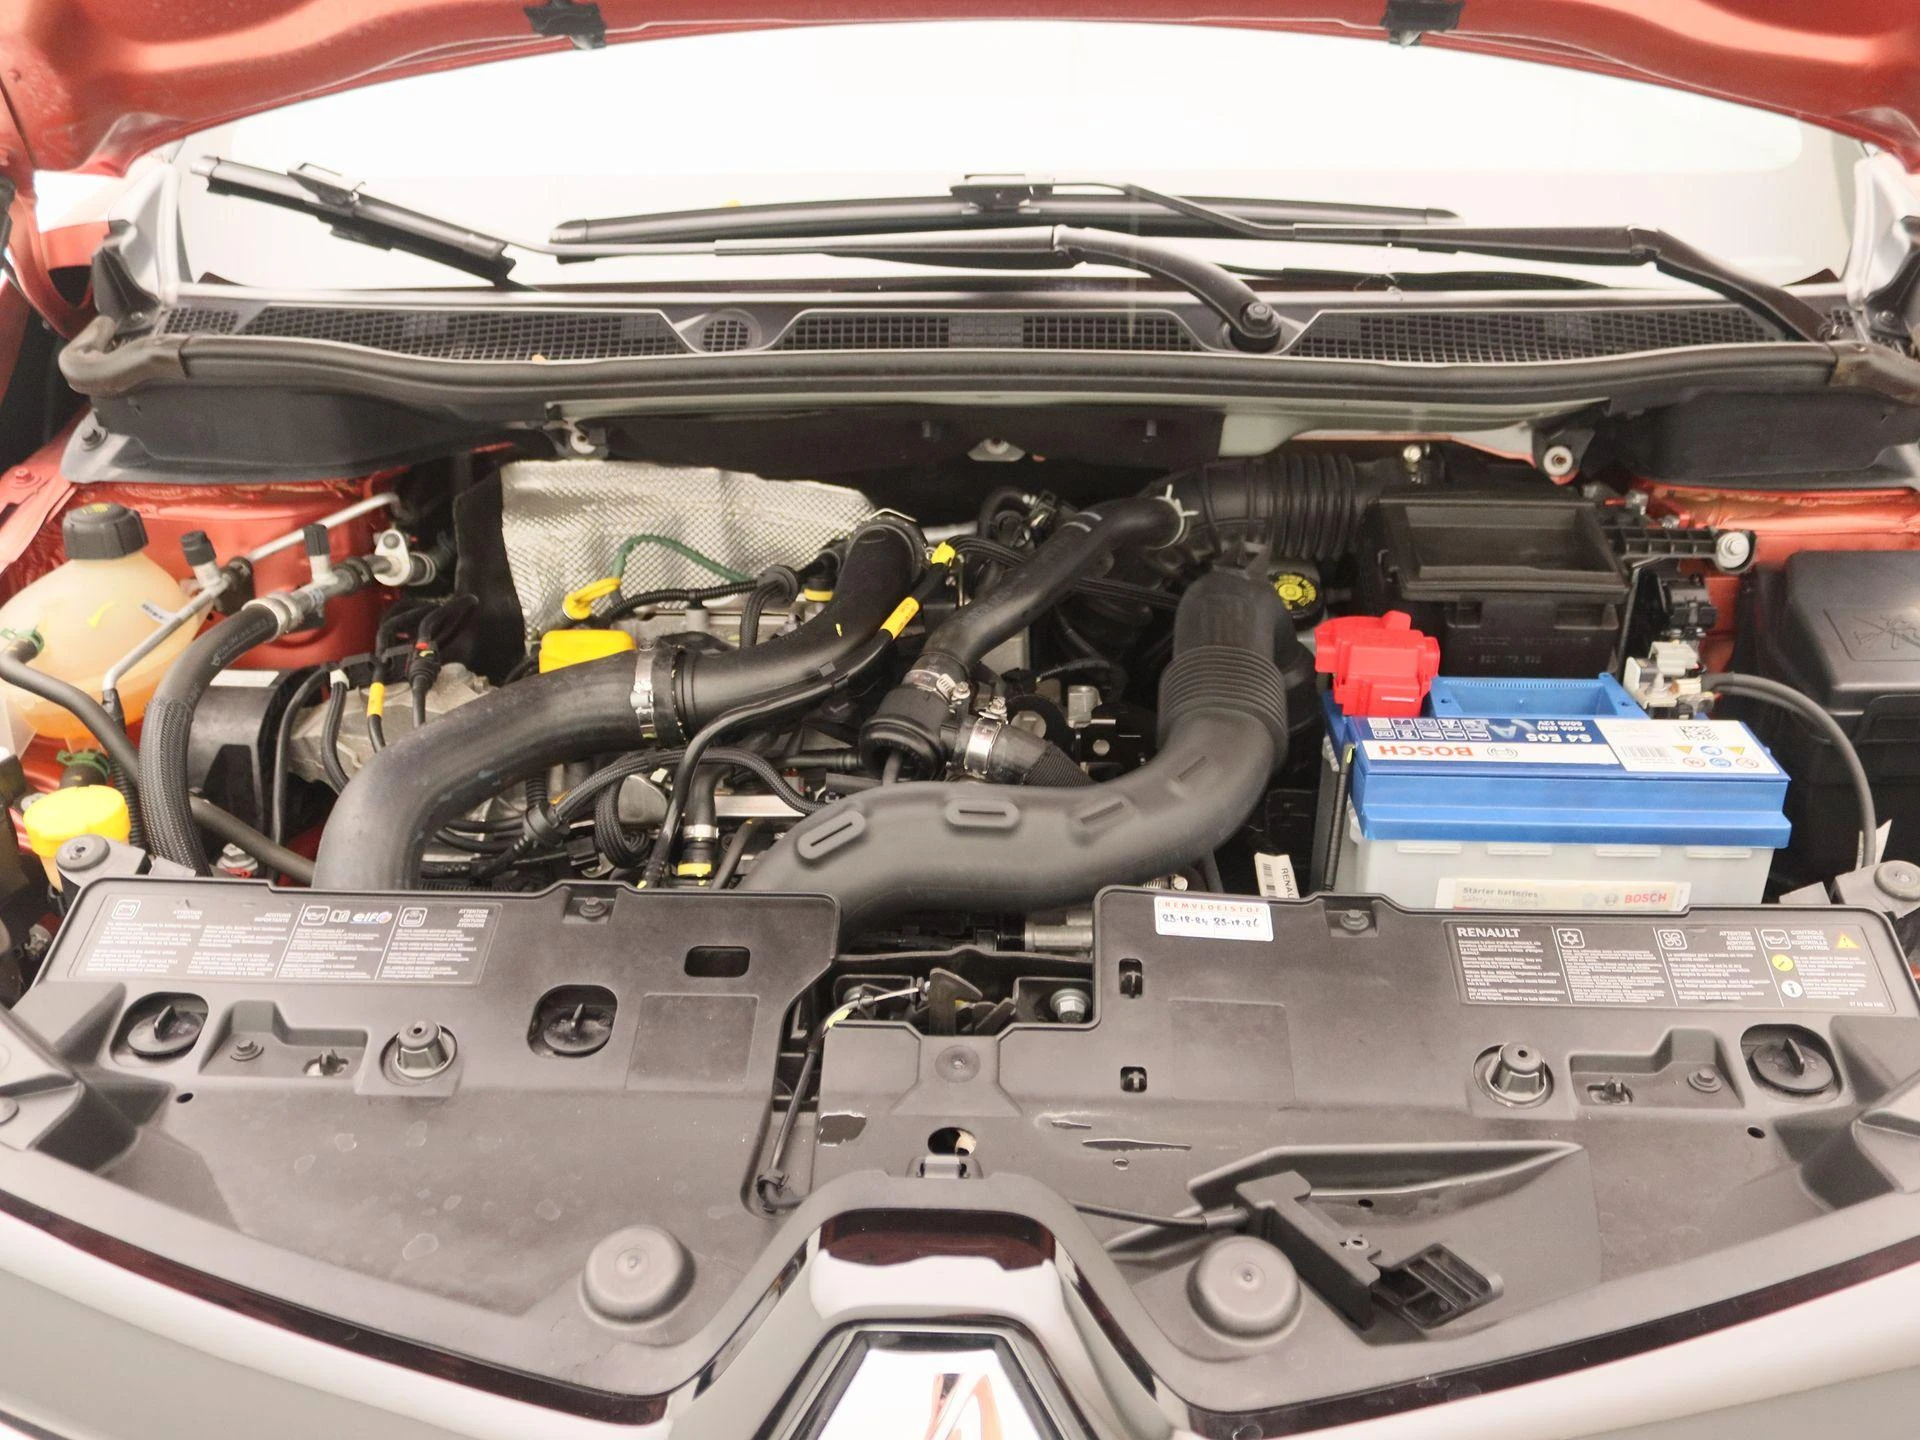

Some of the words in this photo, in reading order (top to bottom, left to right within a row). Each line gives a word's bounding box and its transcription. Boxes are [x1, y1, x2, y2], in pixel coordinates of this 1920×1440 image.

[1525, 733, 1562, 743] E05
[1566, 734, 1592, 743] S4
[1379, 746, 1474, 757] BOSCH
[1463, 887, 1494, 896] Starter
[1497, 887, 1539, 898] batteries
[1624, 892, 1667, 904] BOSCH
[352, 912, 379, 922] elf
[1456, 927, 1521, 938] RENAULT
